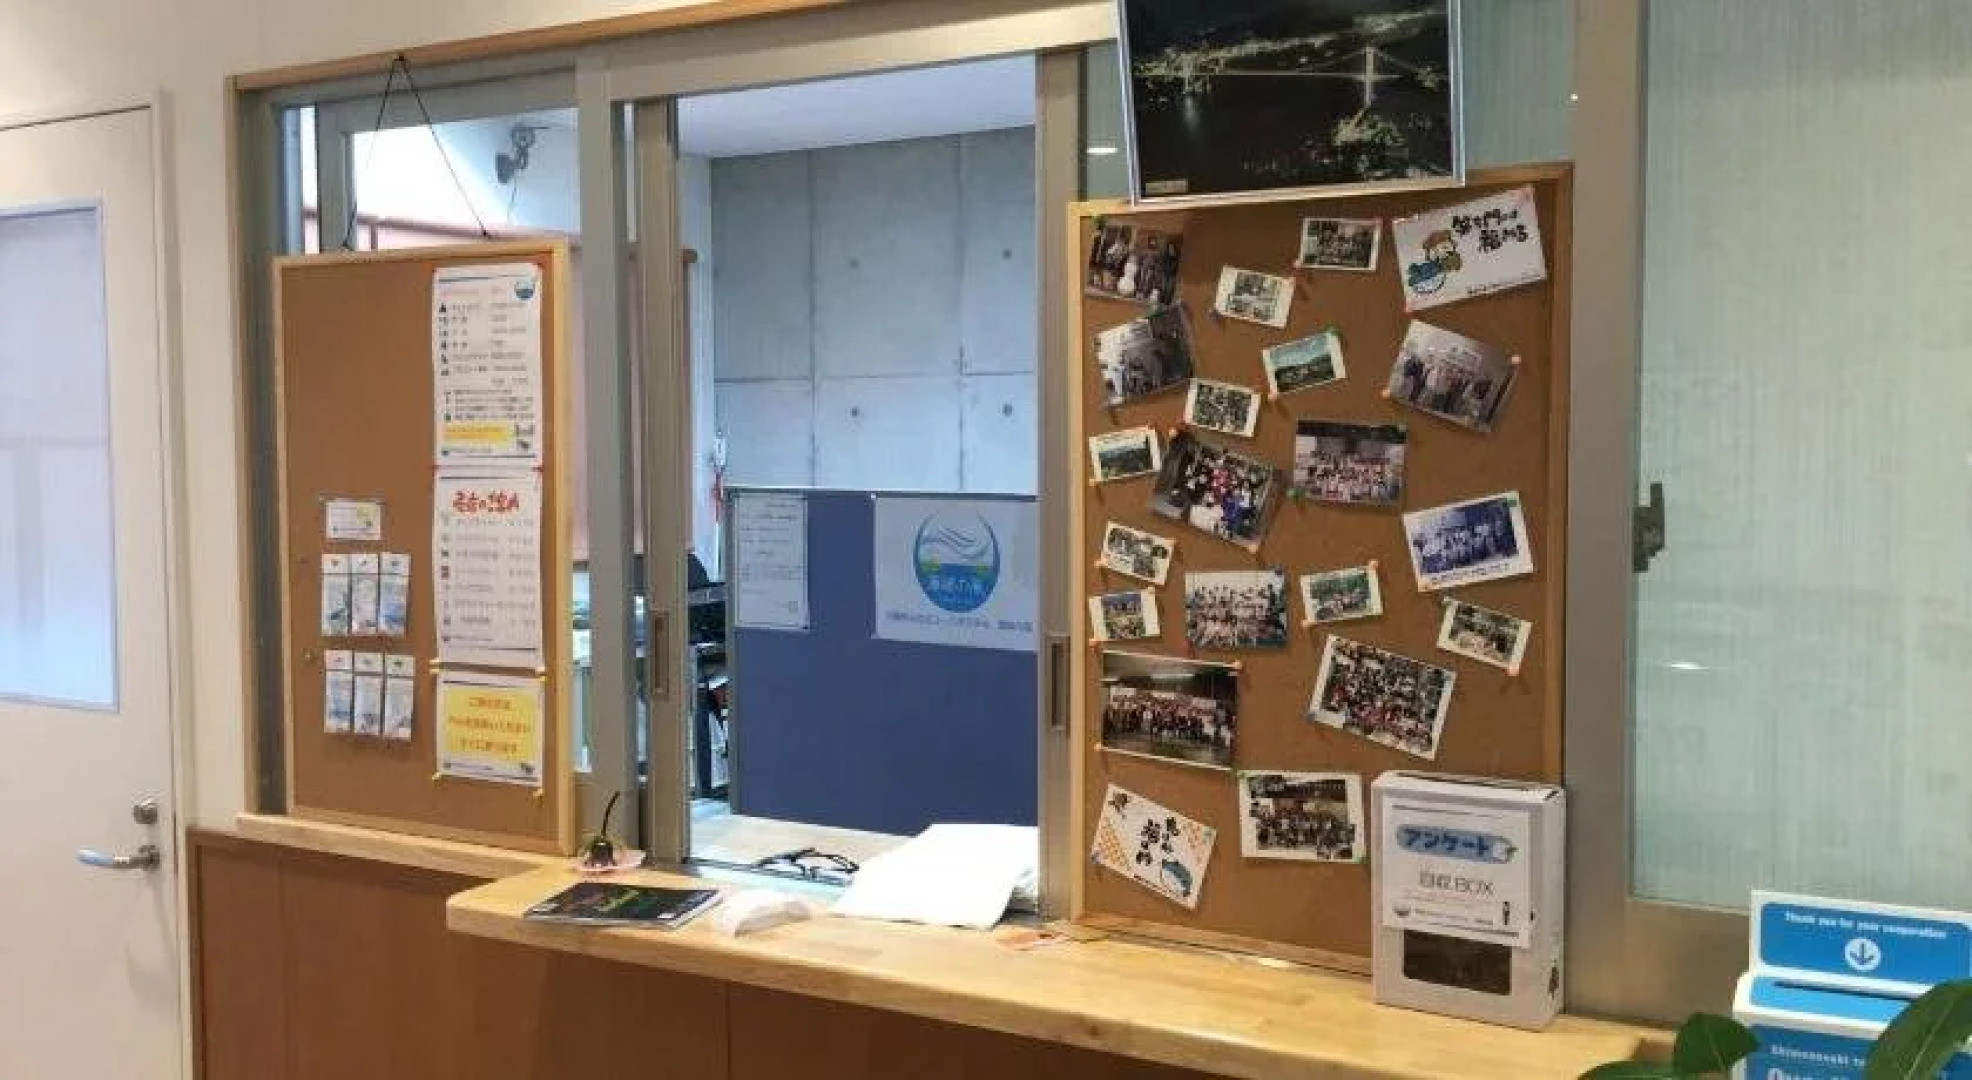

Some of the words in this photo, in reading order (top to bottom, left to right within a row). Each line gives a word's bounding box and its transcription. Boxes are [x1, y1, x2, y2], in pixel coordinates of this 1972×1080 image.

[1403, 827, 1489, 856] アンケート
[1784, 910, 1816, 924] Thank
